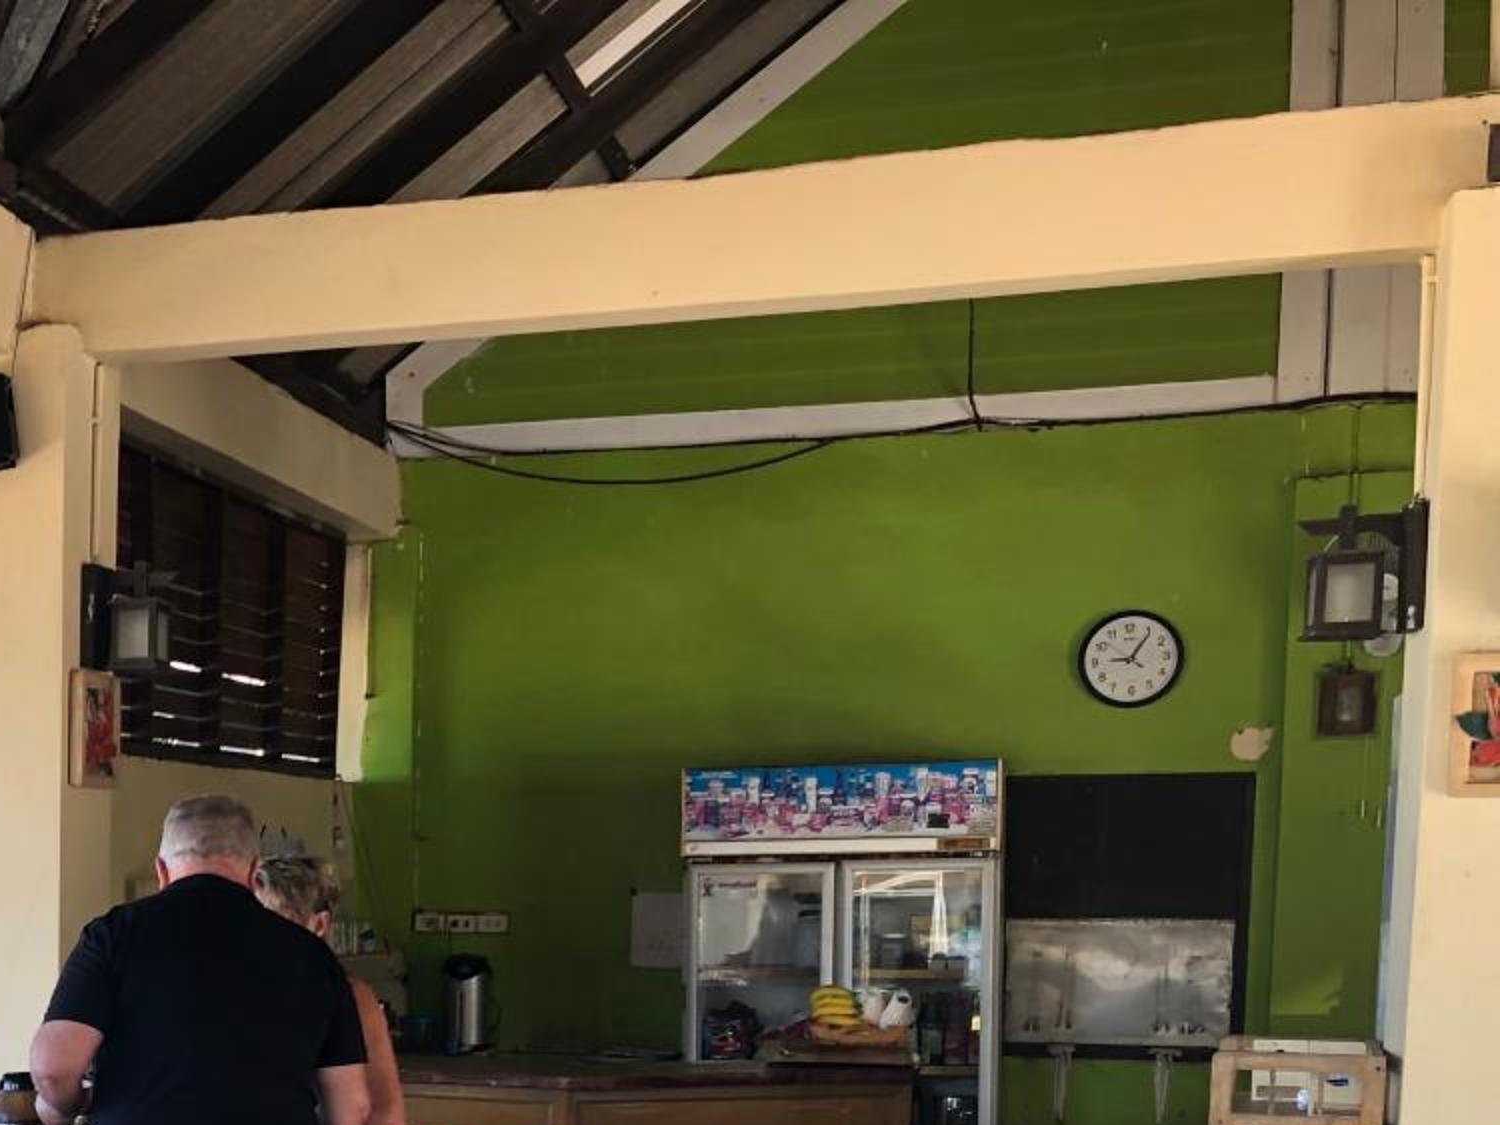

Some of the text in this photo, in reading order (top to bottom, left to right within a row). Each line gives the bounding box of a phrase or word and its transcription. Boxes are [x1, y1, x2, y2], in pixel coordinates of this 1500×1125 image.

[1124, 623, 1135, 633] 12
[1107, 629, 1117, 639] 11
[1095, 641, 1108, 651] 10
[1157, 635, 1166, 647] 2
[1163, 651, 1171, 661] 3
[1091, 657, 1099, 668] 9
[1098, 672, 1107, 682] 8
[1110, 682, 1117, 693] 7
[1145, 679, 1153, 689] 5
[1127, 685, 1137, 696] 6
